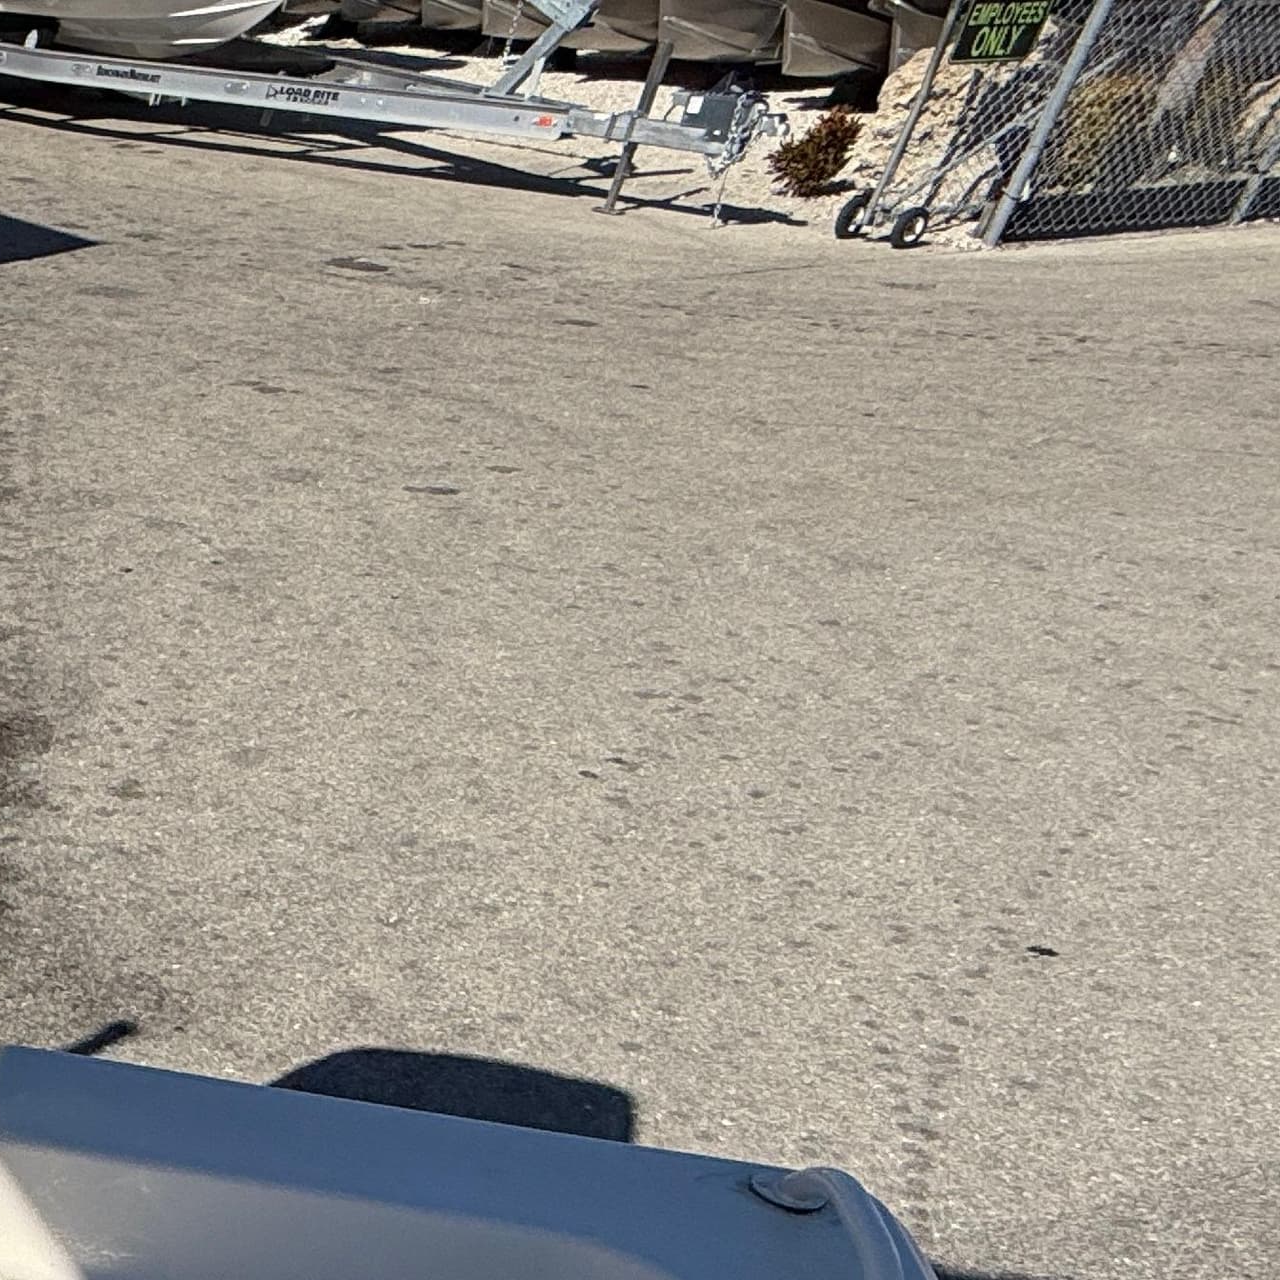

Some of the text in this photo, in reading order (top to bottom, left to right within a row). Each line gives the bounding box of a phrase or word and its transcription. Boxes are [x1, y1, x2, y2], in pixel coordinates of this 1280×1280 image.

[968, 1, 1048, 26] EMPLOYEES
[971, 25, 1026, 56] ONLY
[280, 86, 311, 98] LOAD
